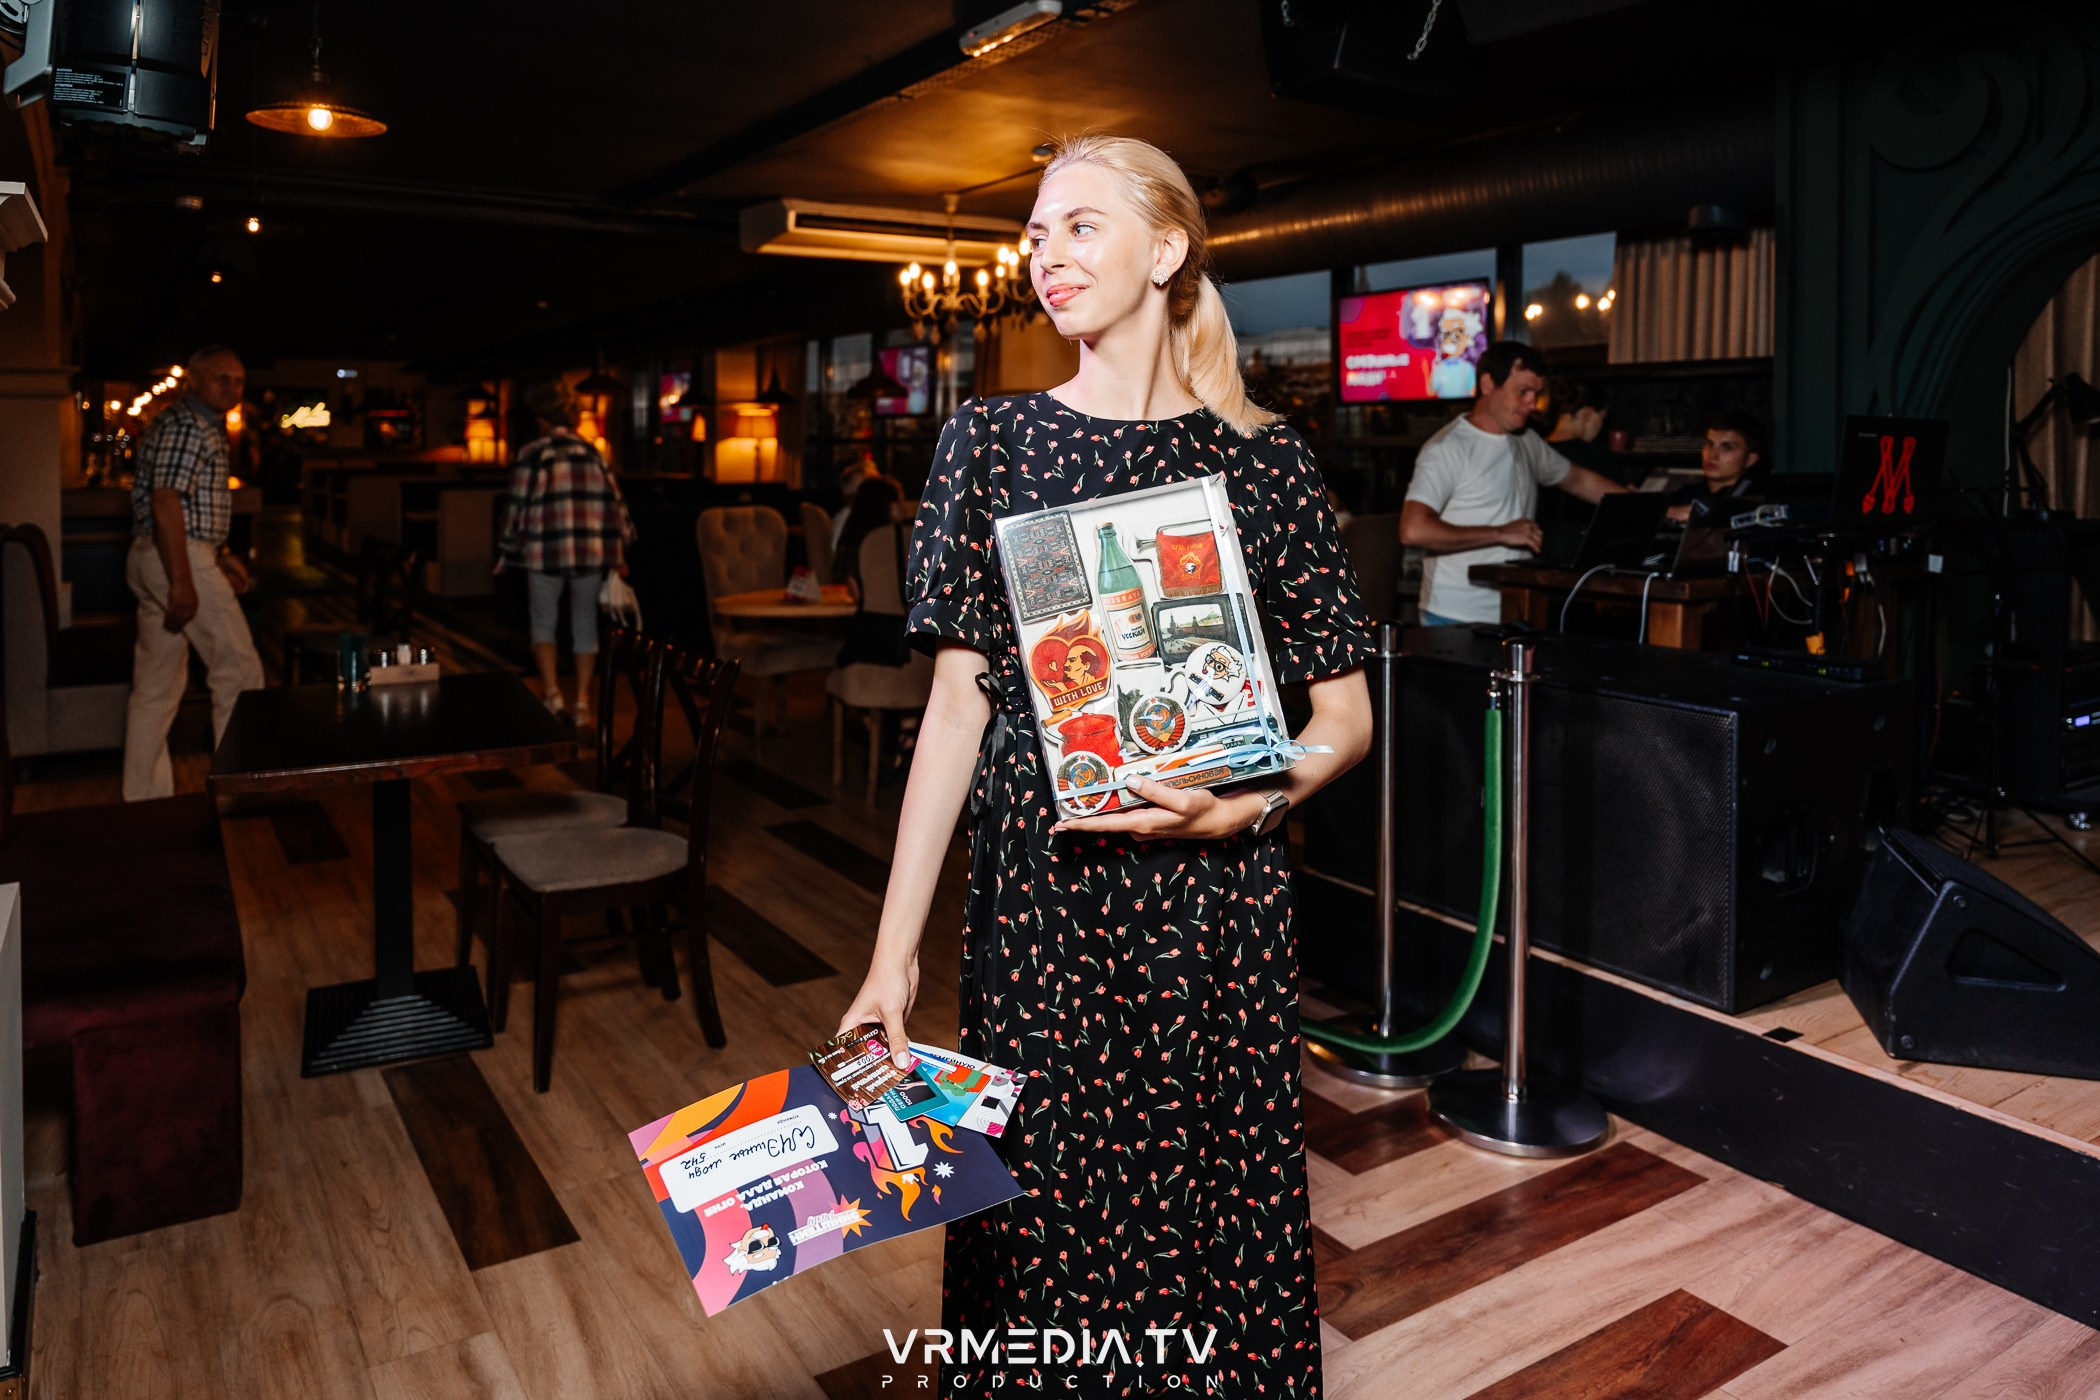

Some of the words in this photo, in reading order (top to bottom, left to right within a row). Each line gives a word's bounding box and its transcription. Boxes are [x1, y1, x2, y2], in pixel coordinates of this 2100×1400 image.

[1053, 691, 1078, 707] WITH
[1080, 681, 1104, 697] LOVE
[900, 1091, 913, 1106] 1000
[680, 1152, 707, 1170] 542
[688, 1159, 723, 1179] люди
[773, 1159, 828, 1187] КОТОРАЯ
[736, 1178, 774, 1201] ДАЛА
[703, 1197, 736, 1217] ОГНЯ
